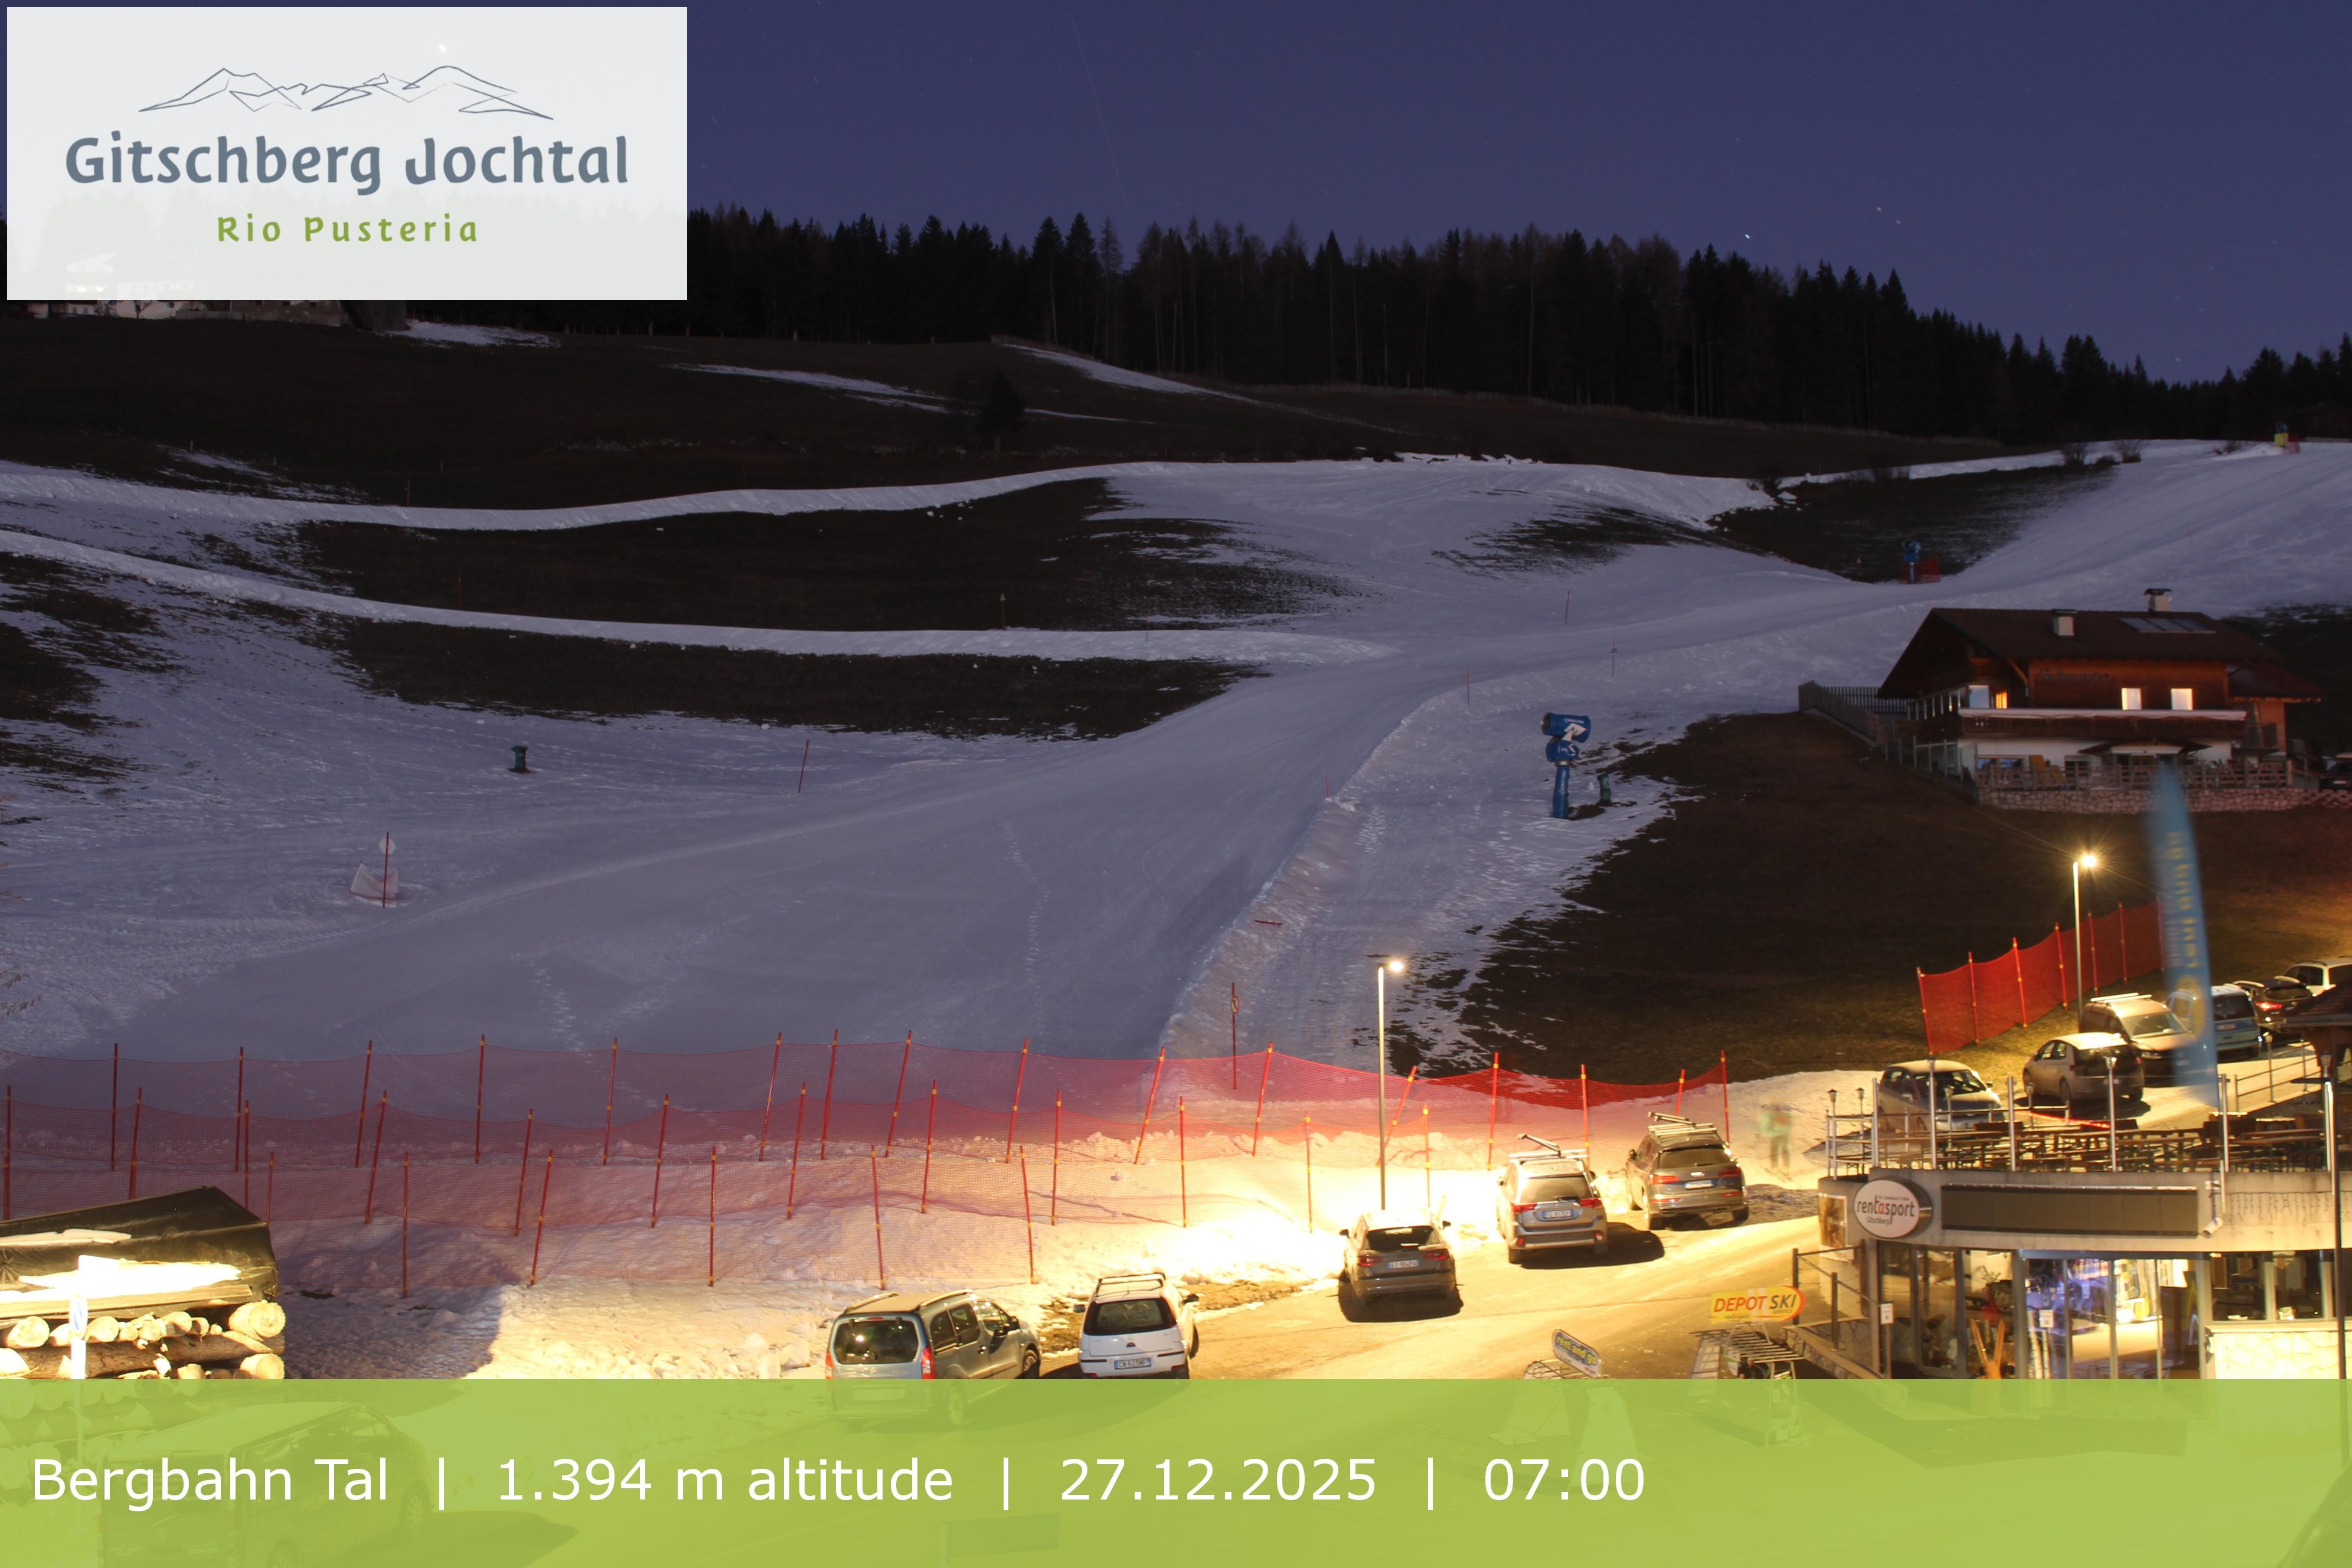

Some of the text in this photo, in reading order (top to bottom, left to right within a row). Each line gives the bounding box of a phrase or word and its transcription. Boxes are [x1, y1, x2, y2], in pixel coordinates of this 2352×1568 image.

[1857, 1195, 1915, 1224] rentasport
[1714, 1294, 1797, 1312] DEPOT SKI
[1586, 1354, 1597, 1365] go
